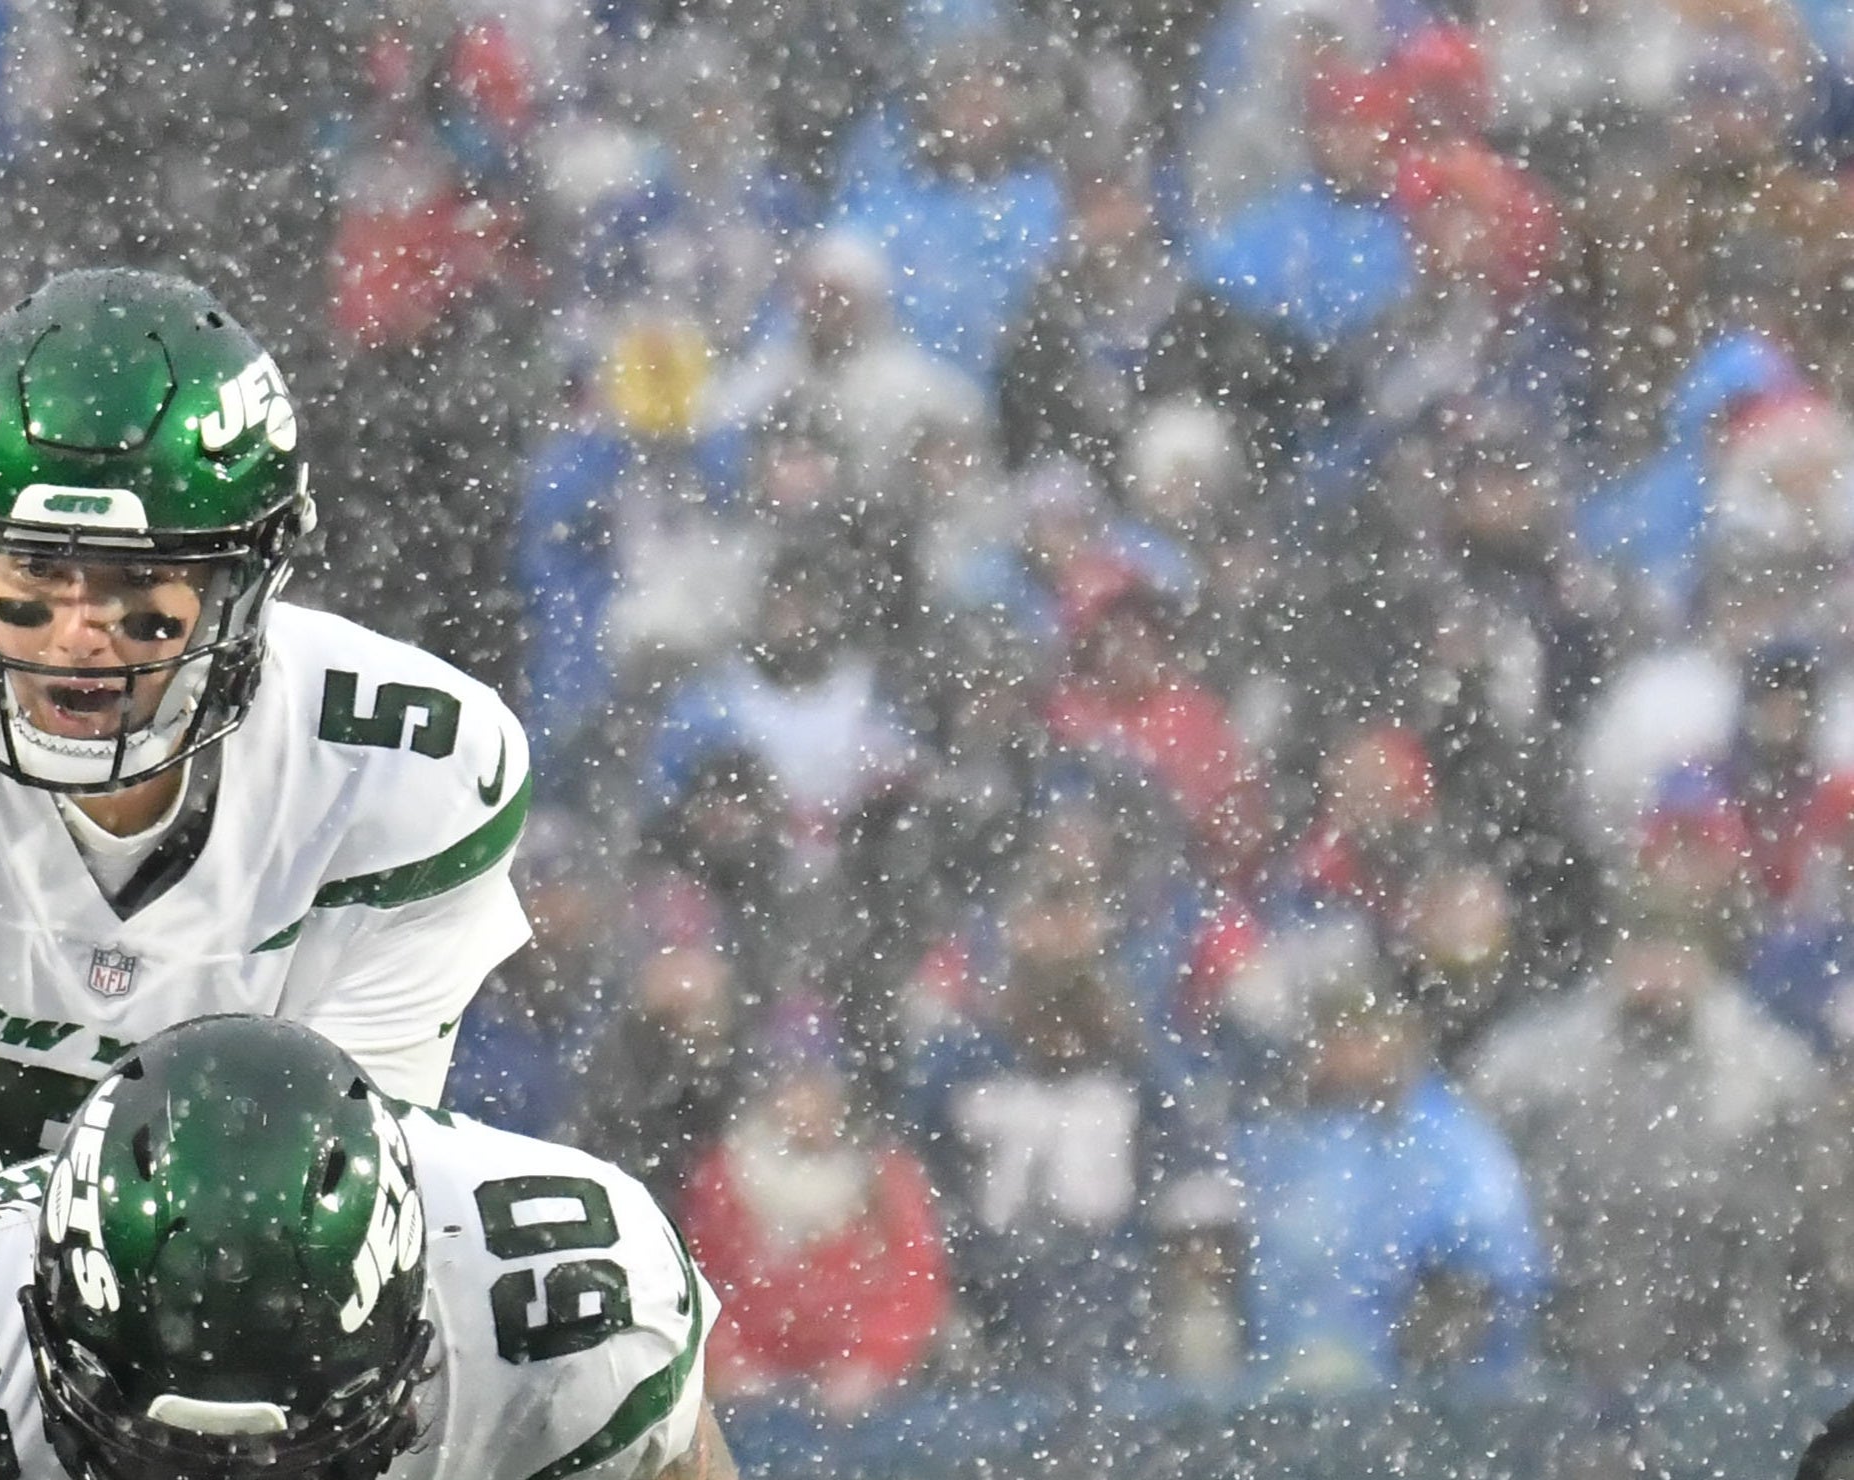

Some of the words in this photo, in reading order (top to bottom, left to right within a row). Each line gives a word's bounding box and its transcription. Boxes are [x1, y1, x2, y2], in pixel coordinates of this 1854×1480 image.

[318, 669, 460, 760] 5
[69, 1074, 121, 1313] JETS
[473, 1175, 635, 1365] 60
